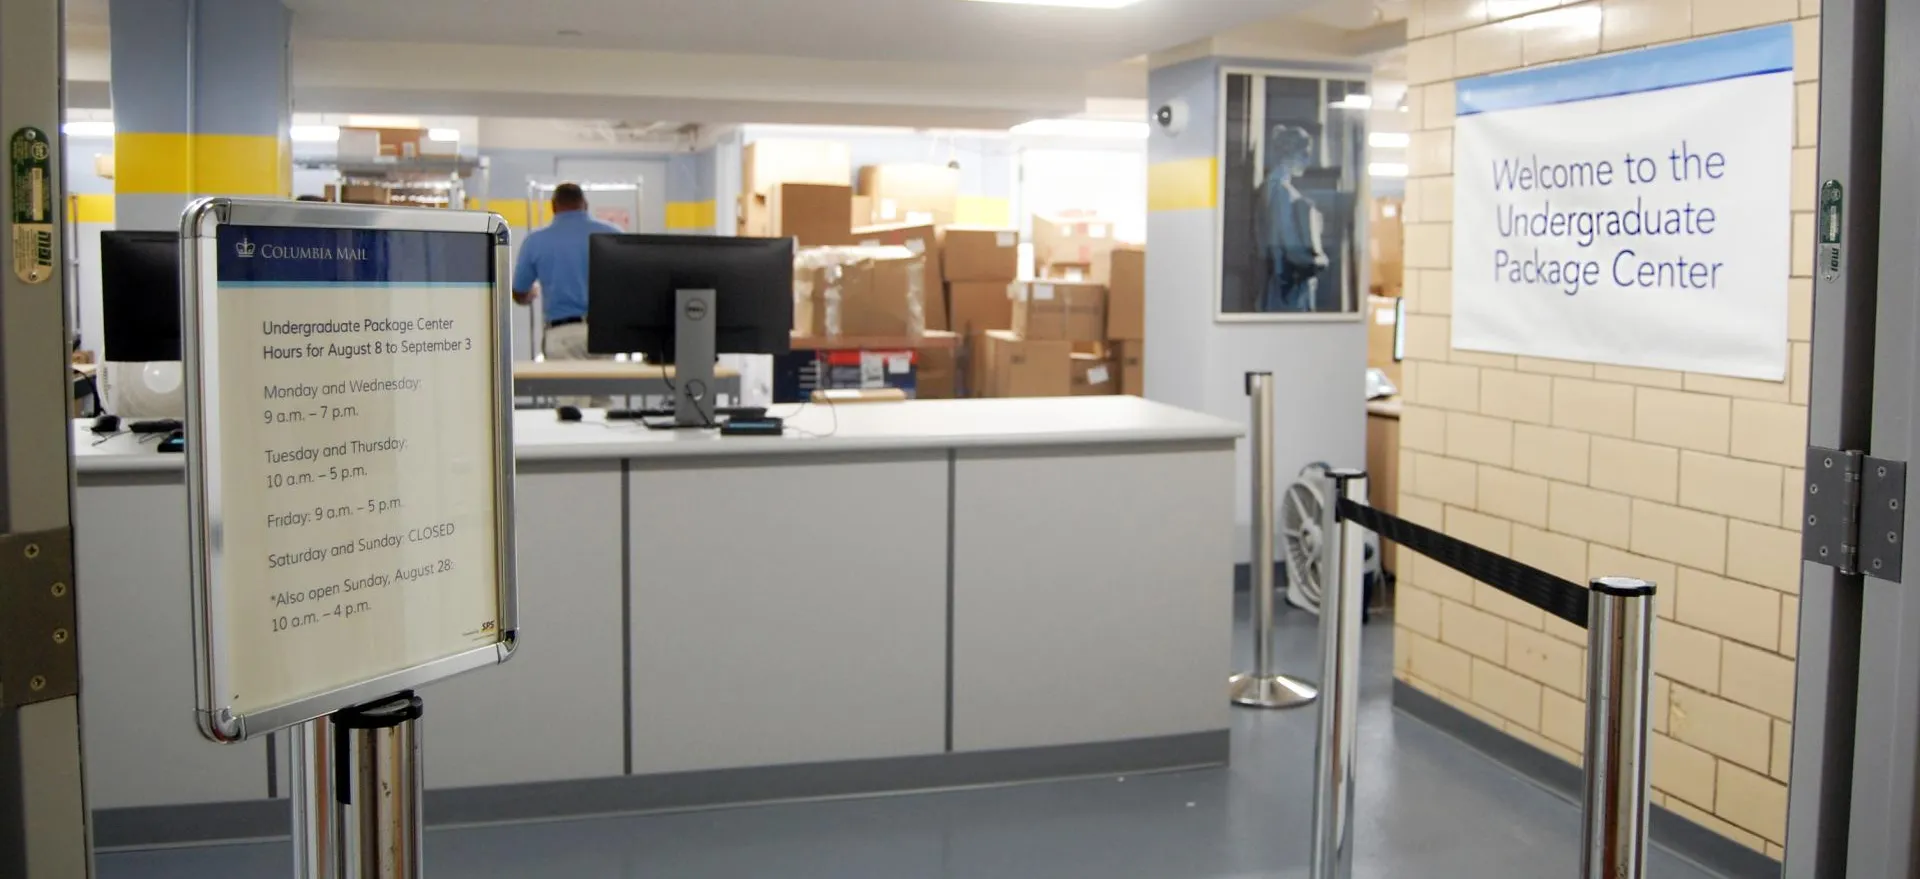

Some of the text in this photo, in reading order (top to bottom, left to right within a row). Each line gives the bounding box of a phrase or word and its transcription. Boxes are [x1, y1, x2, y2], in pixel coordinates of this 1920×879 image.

[1492, 140, 1726, 191] Welcome to the
[1496, 196, 1716, 247] Undergraduate
[261, 244, 367, 260] COLUMBIA MAIL
[1494, 248, 1724, 296] Package Center
[263, 317, 454, 337] Undergraduate Package Center
[263, 337, 472, 359] Hours for August 8 to September 3
[264, 382, 318, 399] Monday
[322, 380, 346, 394] and
[264, 409, 273, 424] 9
[276, 410, 305, 423] a.m.
[320, 405, 328, 418] 7
[332, 406, 359, 421] p.m.
[265, 446, 319, 463] Tuesday
[323, 442, 346, 457] and
[267, 473, 283, 488] 10
[286, 472, 315, 486] a.m.
[329, 466, 338, 480] 5
[341, 466, 368, 481] p.m.
[267, 512, 311, 528] Friday:
[315, 507, 323, 521] 9
[326, 506, 354, 519] a.m.
[368, 499, 375, 513] 5
[268, 547, 327, 569] Saturday
[330, 540, 354, 557] and
[408, 522, 455, 542] CLOSED
[308, 584, 340, 601] open
[343, 573, 391, 593] Sunday,
[394, 567, 434, 582] August
[437, 558, 454, 573] 28:
[272, 616, 288, 632] 10
[291, 613, 319, 628] a.m.
[333, 604, 342, 617] 4
[345, 601, 371, 618] p.m.
